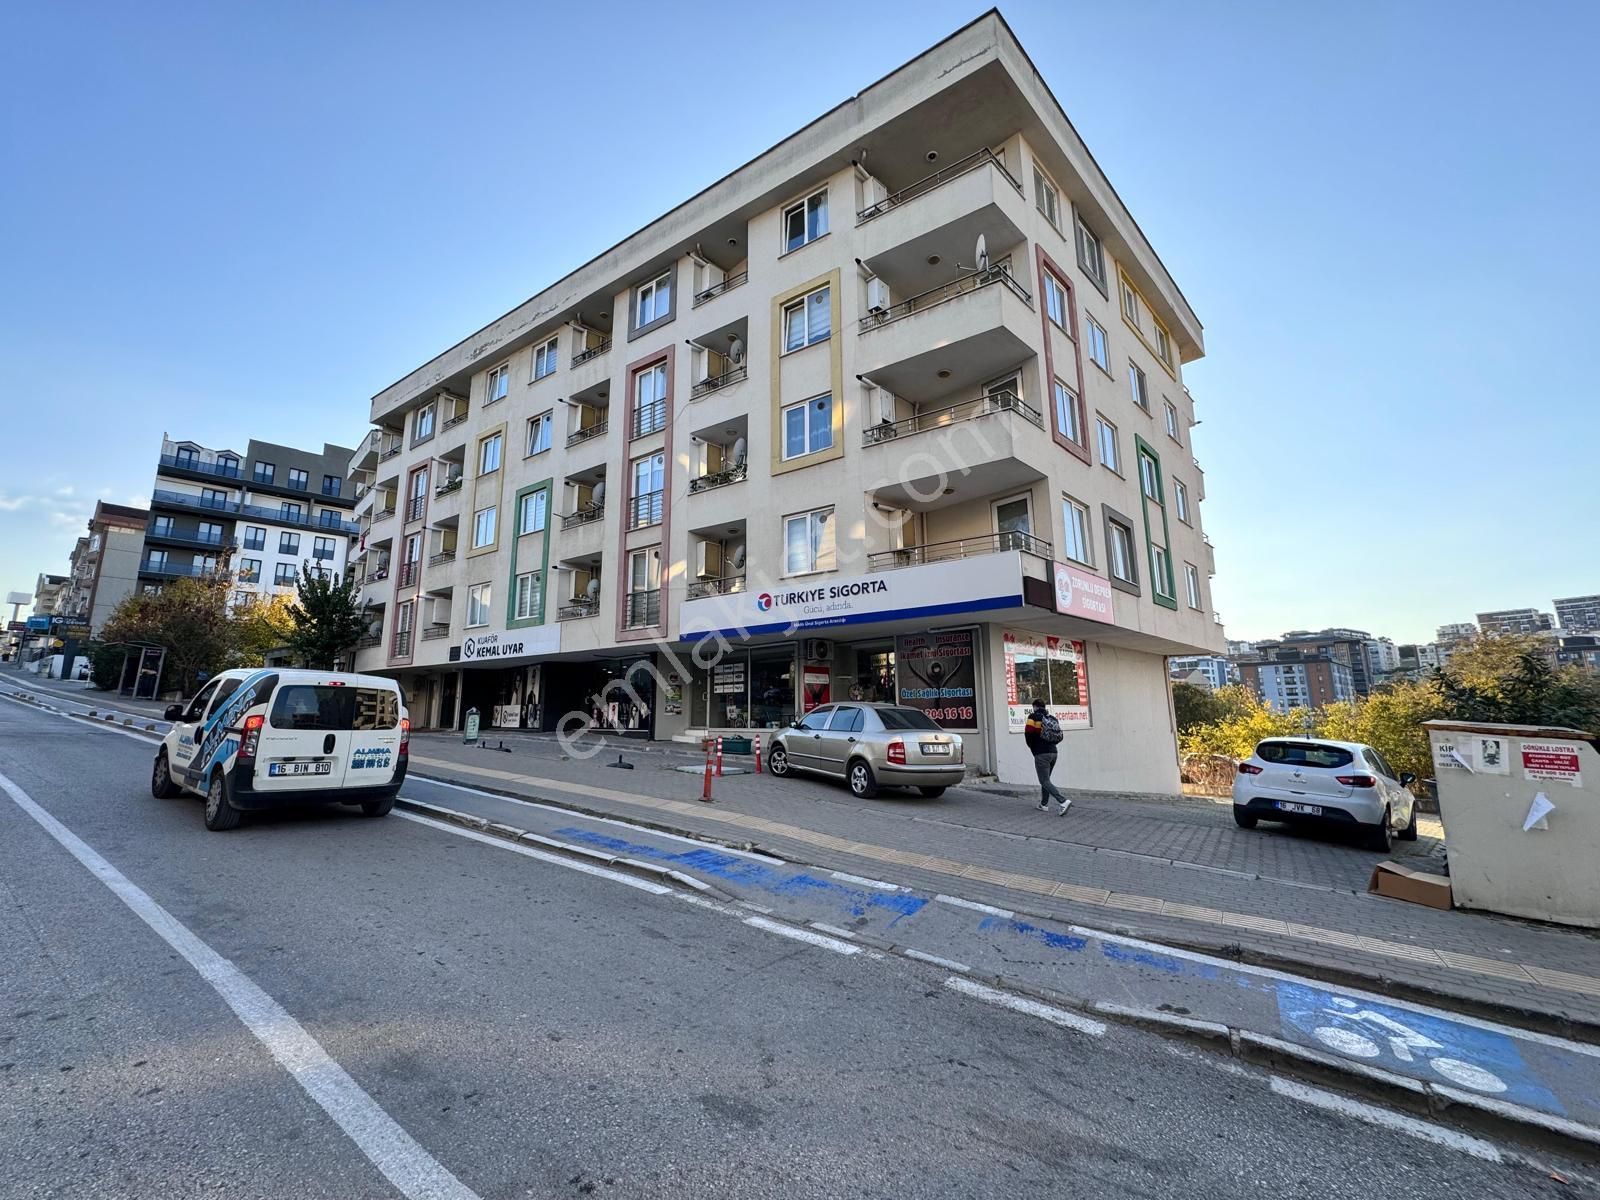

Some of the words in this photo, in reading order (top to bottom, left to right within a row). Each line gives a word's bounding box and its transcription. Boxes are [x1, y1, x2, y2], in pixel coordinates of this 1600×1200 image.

[476, 645, 501, 658] KEMAL
[502, 642, 524, 655] UYAR
[944, 706, 957, 719] 16
[958, 706, 973, 719] 16
[276, 763, 286, 773] 16
[293, 763, 309, 773] BIN
